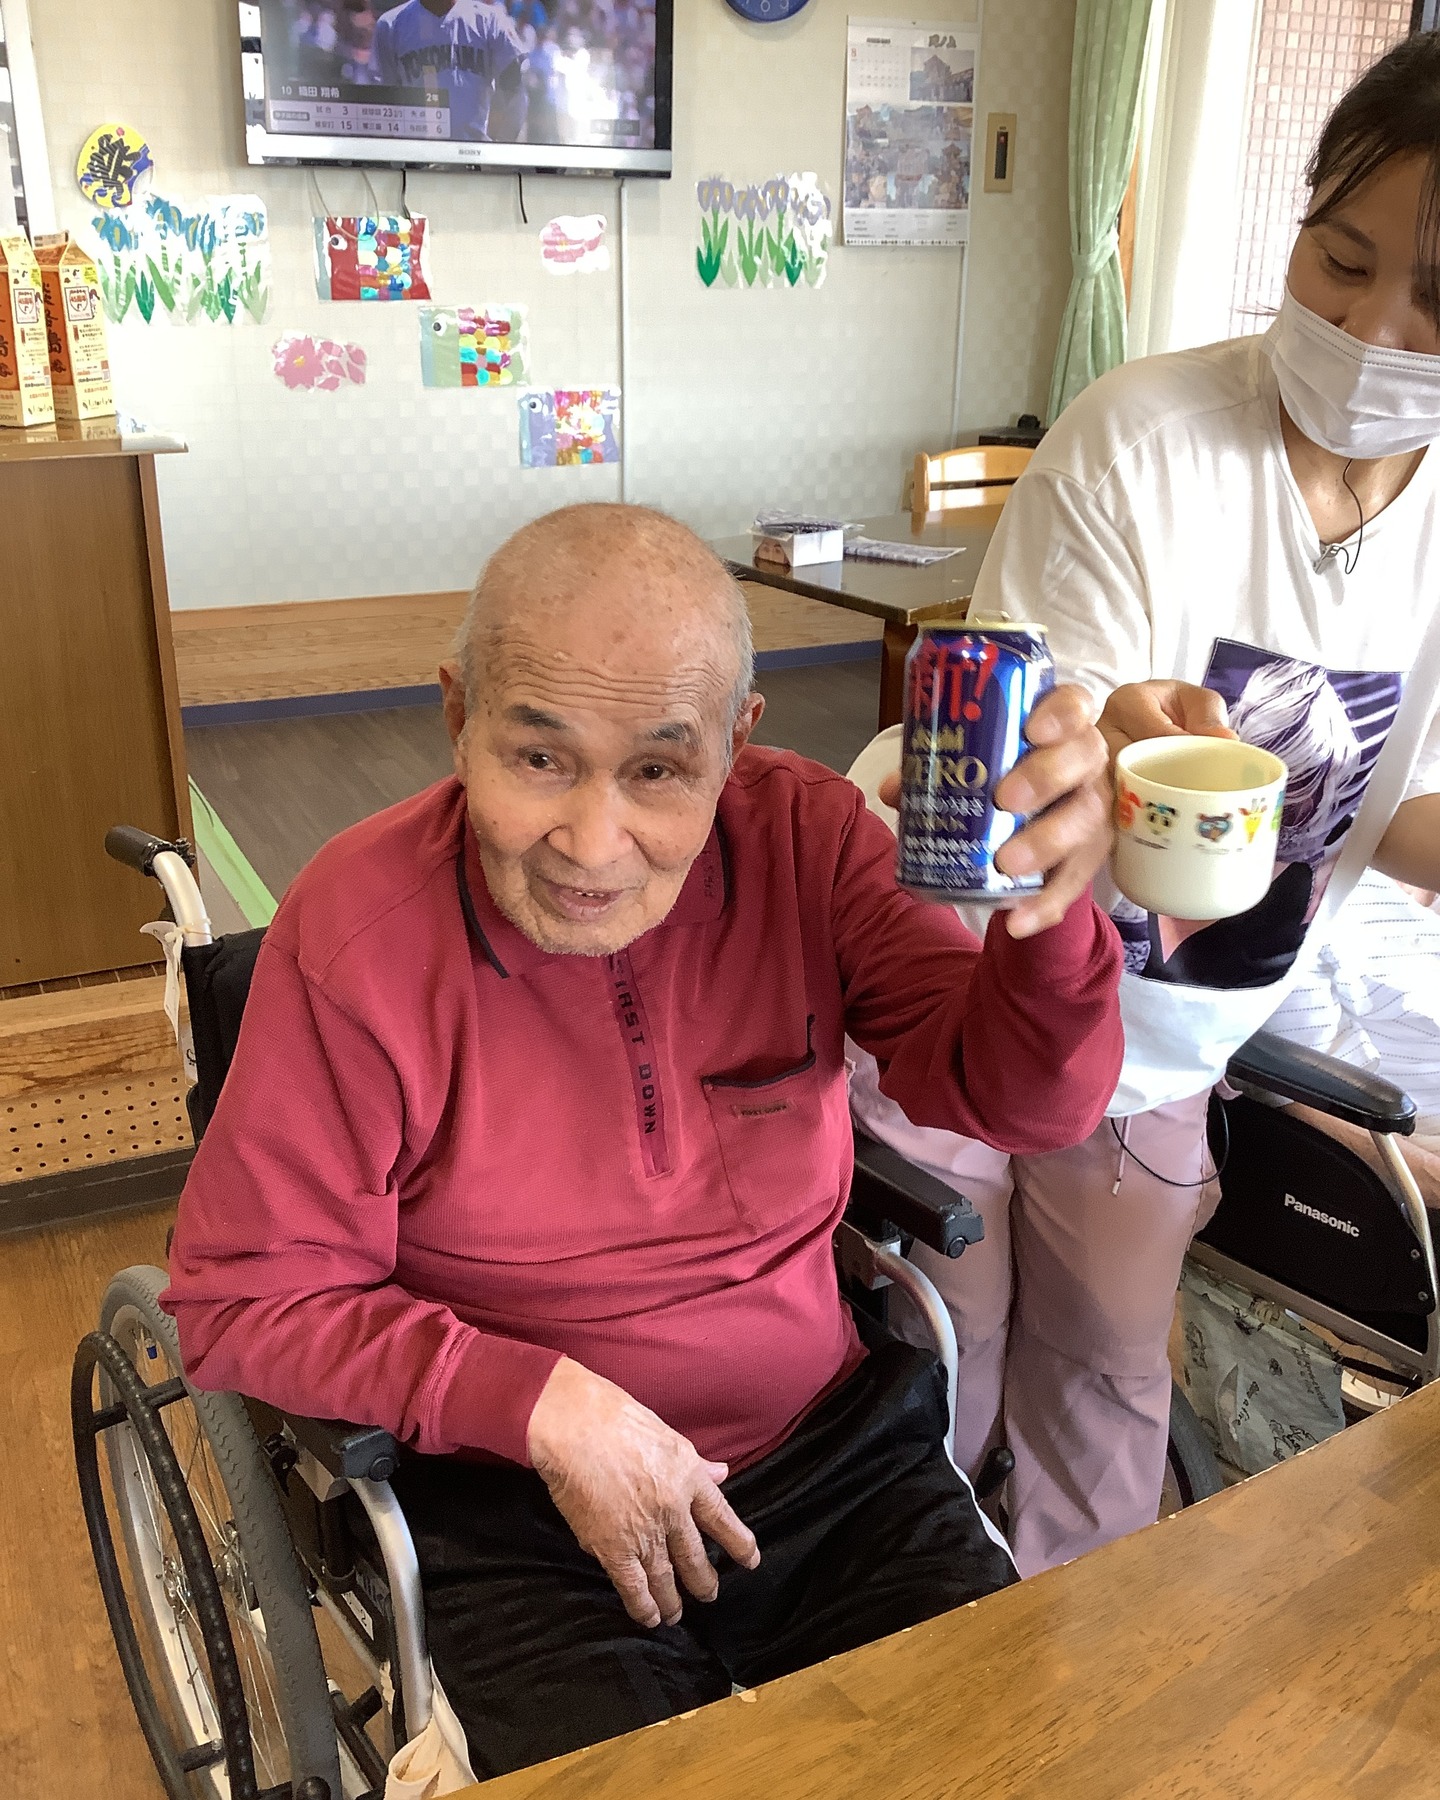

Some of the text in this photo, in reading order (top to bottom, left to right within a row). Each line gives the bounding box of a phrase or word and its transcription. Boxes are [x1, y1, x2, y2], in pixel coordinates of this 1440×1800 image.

[342, 106, 349, 116] 3
[340, 121, 353, 131] 15
[387, 122, 400, 132] 14
[638, 1063, 657, 1136] DOWN
[1283, 1192, 1360, 1238] Panasonic
